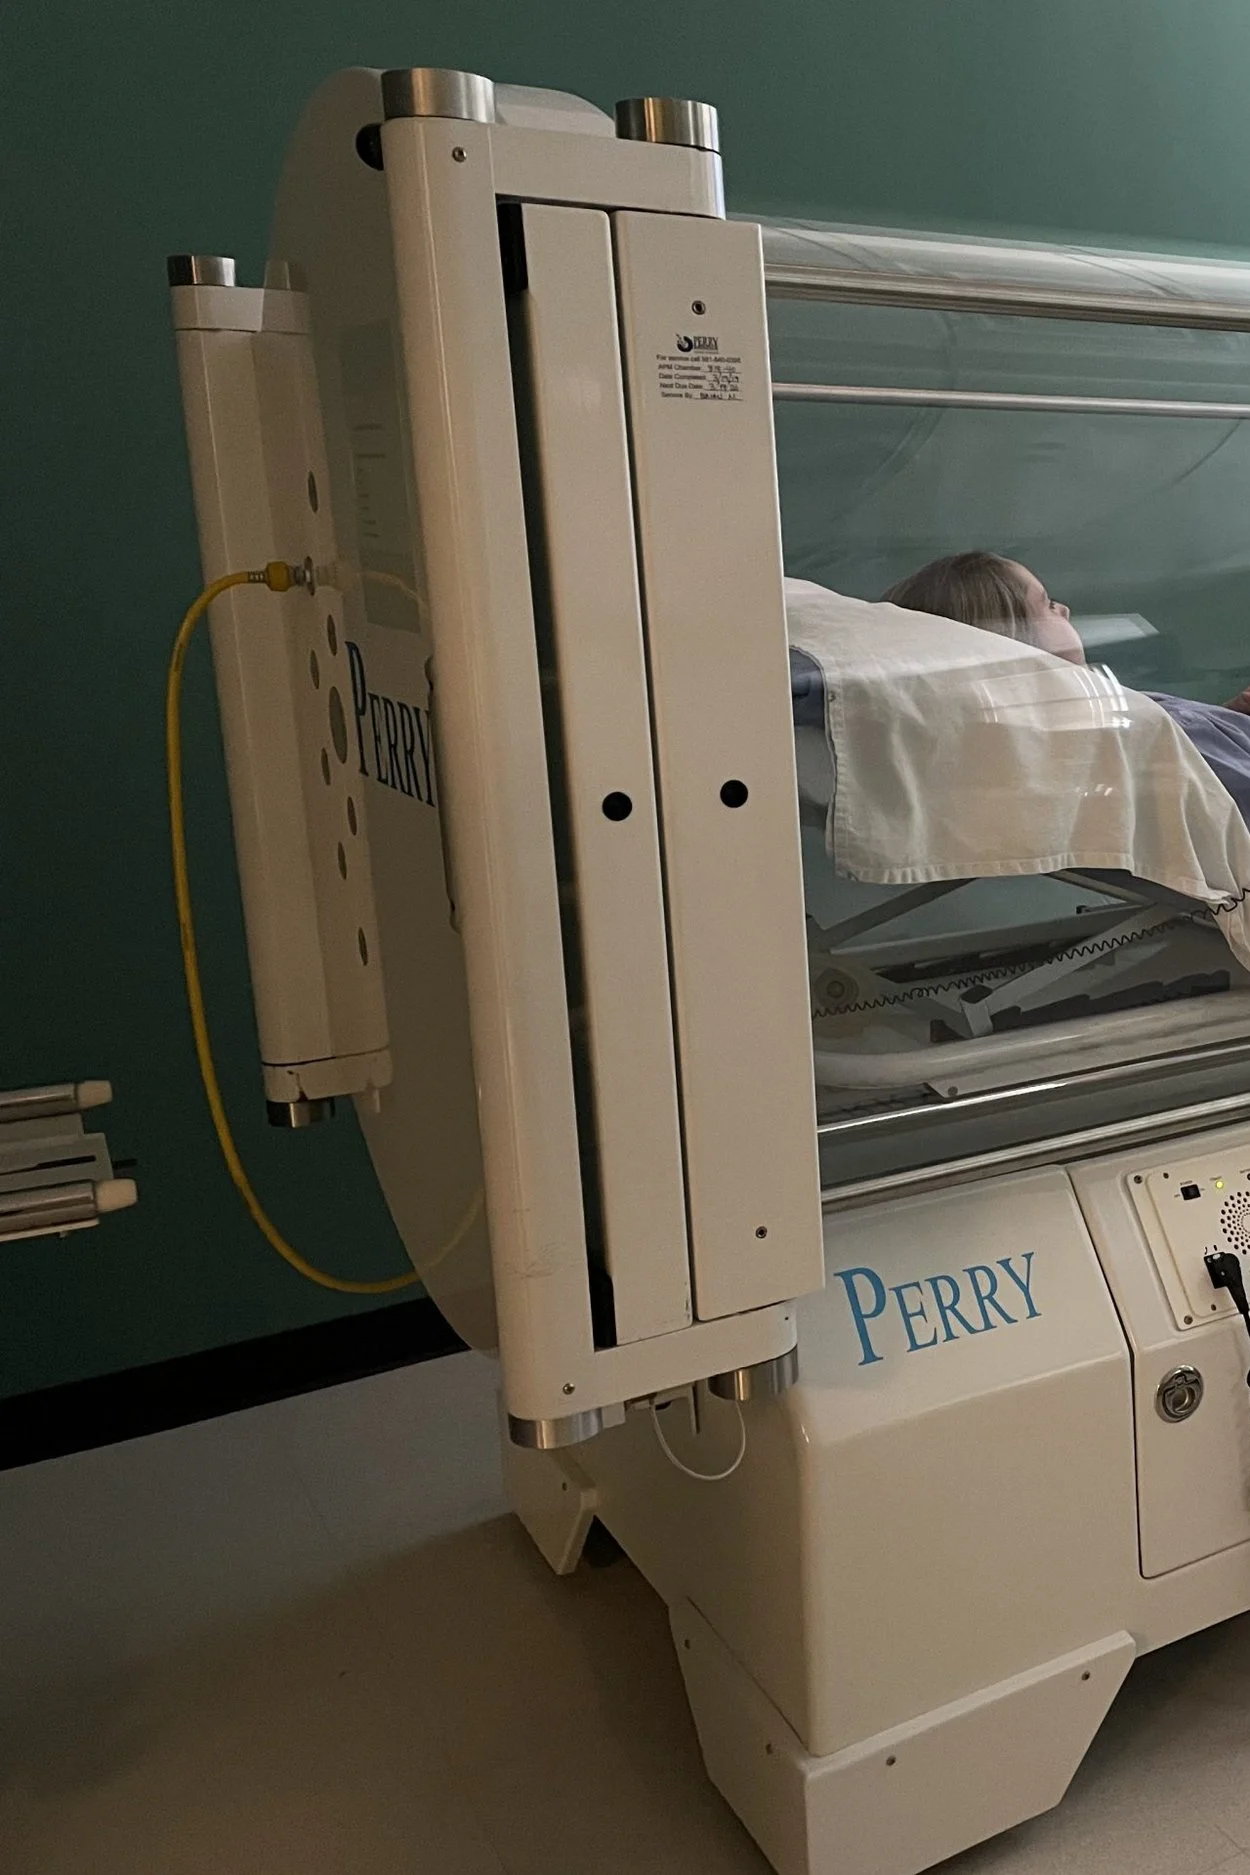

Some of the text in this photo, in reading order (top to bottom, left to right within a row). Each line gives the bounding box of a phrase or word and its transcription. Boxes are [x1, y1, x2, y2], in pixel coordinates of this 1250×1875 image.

[693, 336, 719, 350] PERRY
[345, 640, 436, 808] PERRY
[833, 1252, 1042, 1365] PERRY
